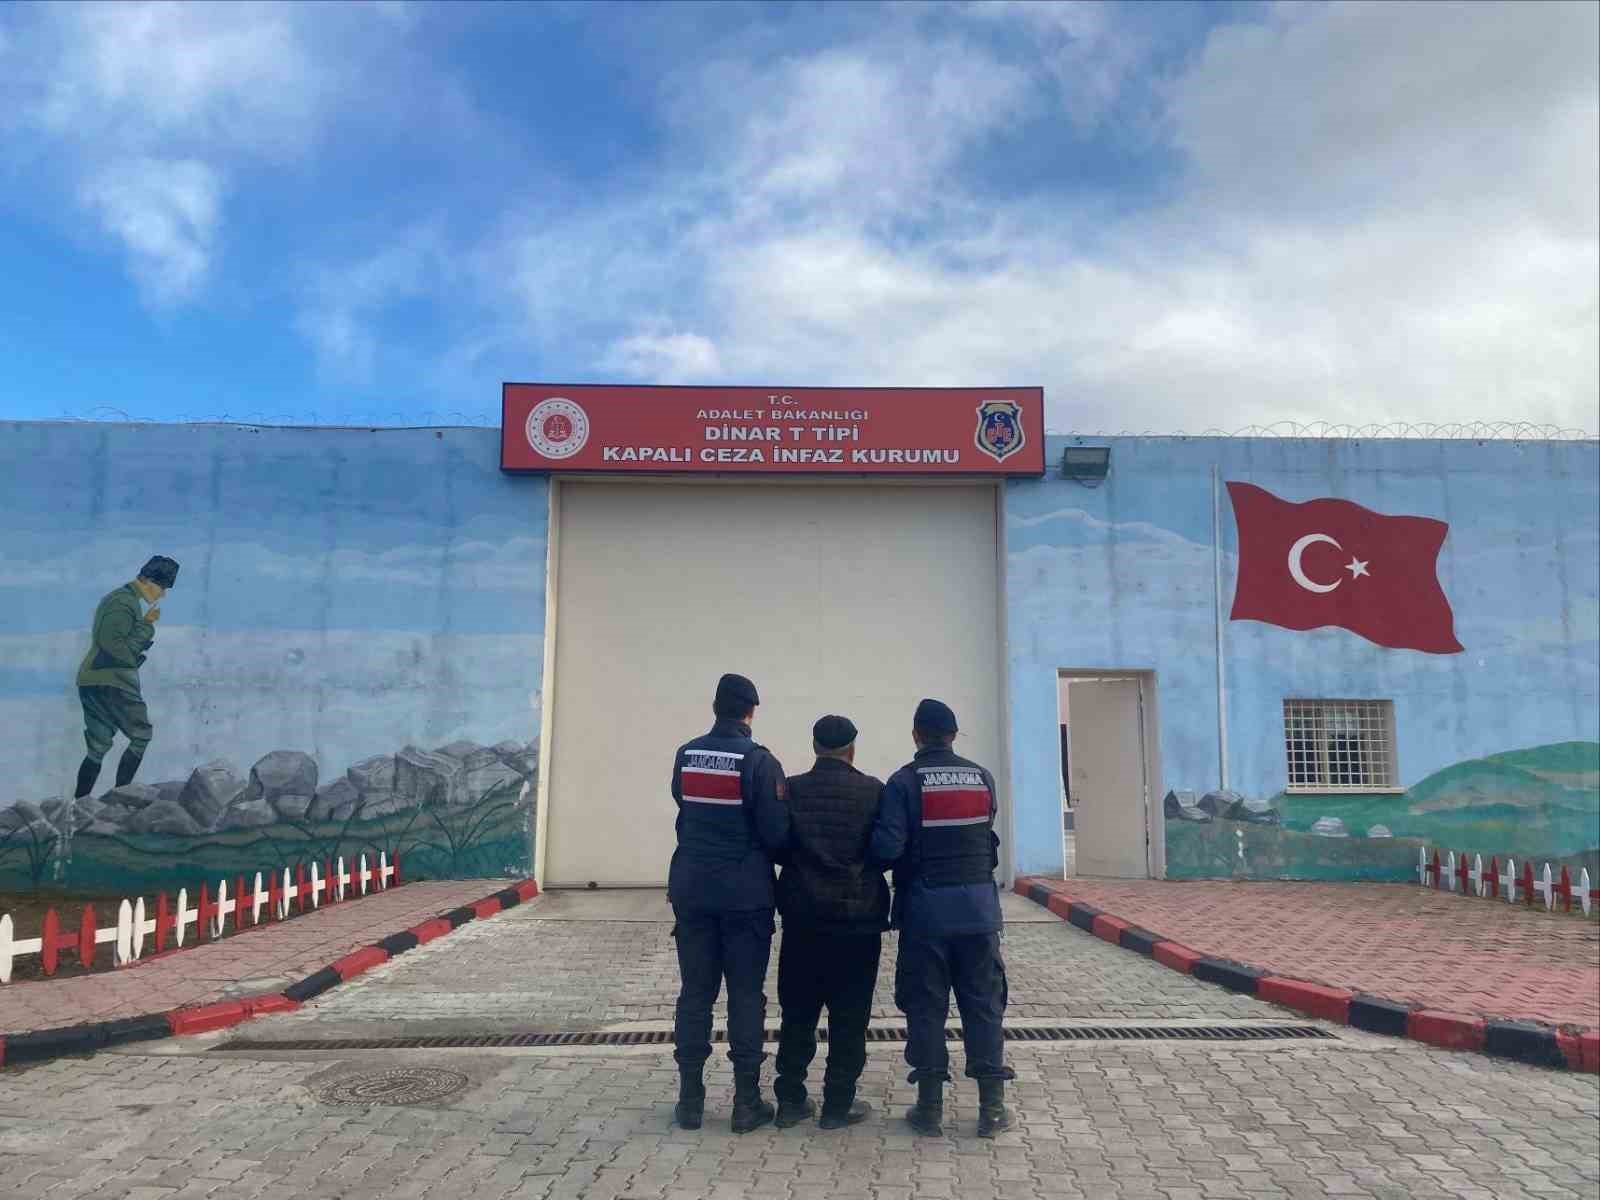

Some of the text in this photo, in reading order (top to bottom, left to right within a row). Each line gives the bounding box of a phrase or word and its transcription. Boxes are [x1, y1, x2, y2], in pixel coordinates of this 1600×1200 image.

[768, 395, 799, 405] T.C.
[696, 408, 869, 421] ADALET BAKANLIĞI
[705, 424, 860, 441] DİNAR T TİPİ
[603, 446, 960, 463] KAPALI CEZA İNFAZ KURUMU
